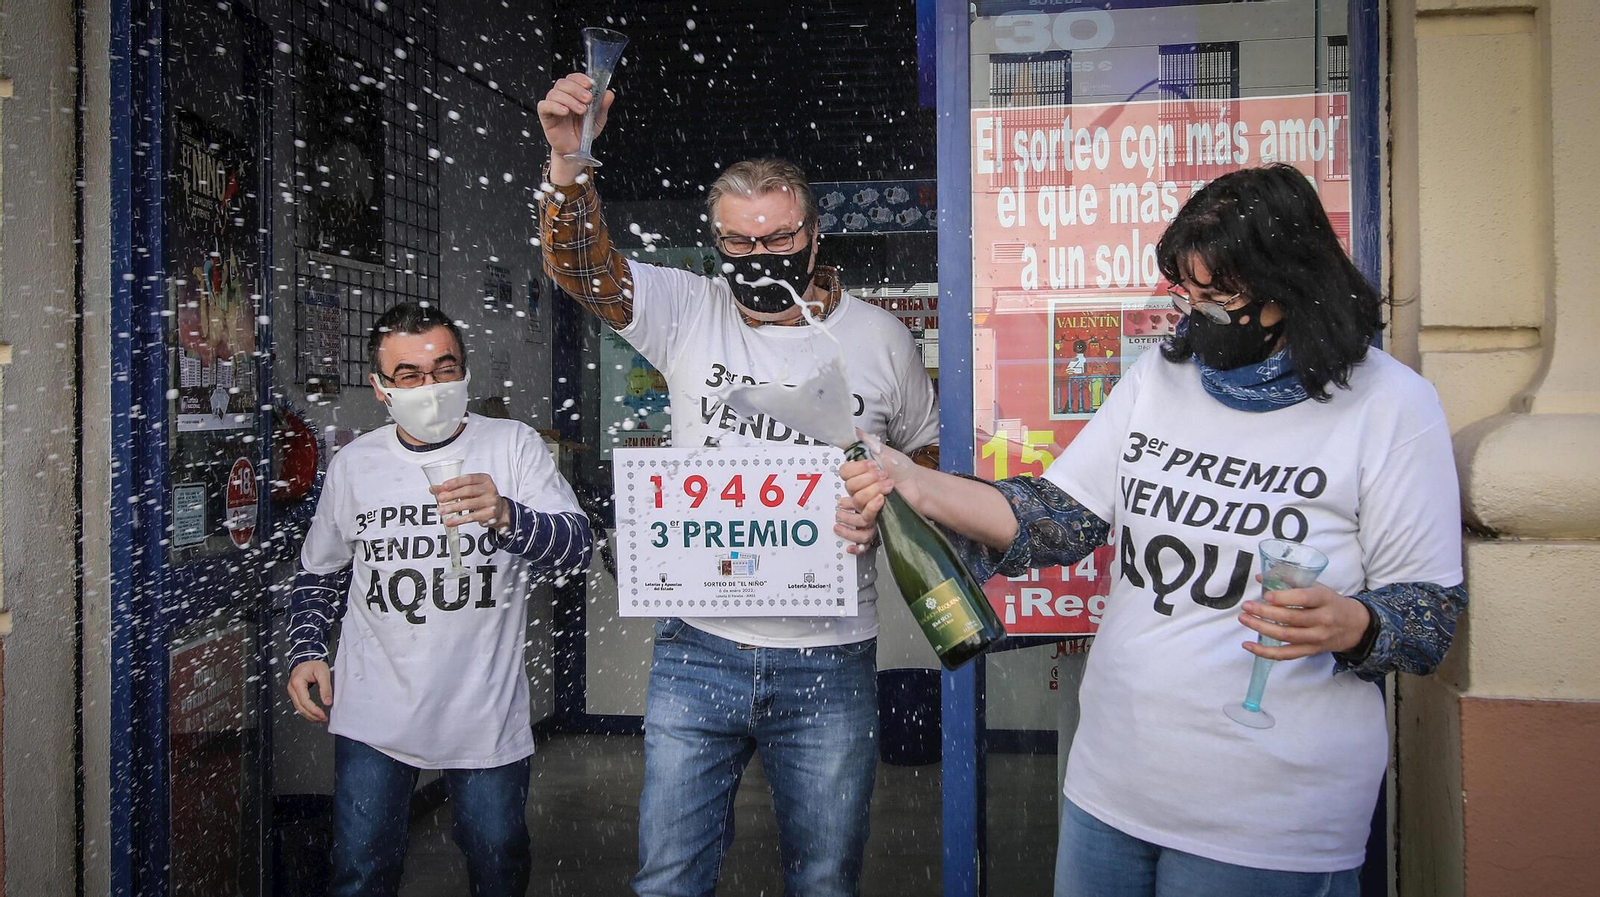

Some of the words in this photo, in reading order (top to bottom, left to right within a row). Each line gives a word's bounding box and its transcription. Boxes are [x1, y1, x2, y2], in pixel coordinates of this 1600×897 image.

[994, 6, 1115, 53] 30
[976, 117, 1002, 174] El
[1014, 118, 1111, 173] sorteo
[1120, 124, 1175, 169] con
[1186, 108, 1249, 166] más
[1261, 118, 1340, 163] amor
[997, 165, 1026, 228] el
[1037, 184, 1098, 239] que
[1110, 172, 1179, 224] más
[1020, 246, 1038, 290] a
[1049, 245, 1085, 289] un
[1095, 229, 1159, 288] solo
[650, 473, 823, 508] 19467
[1122, 432, 1168, 464] 3er
[1162, 447, 1327, 499] PREMIO
[683, 518, 819, 548] PREMIO
[1120, 475, 1309, 543] VENDIDO
[366, 558, 498, 625] AQUÍ
[1121, 524, 1254, 616] AQU
